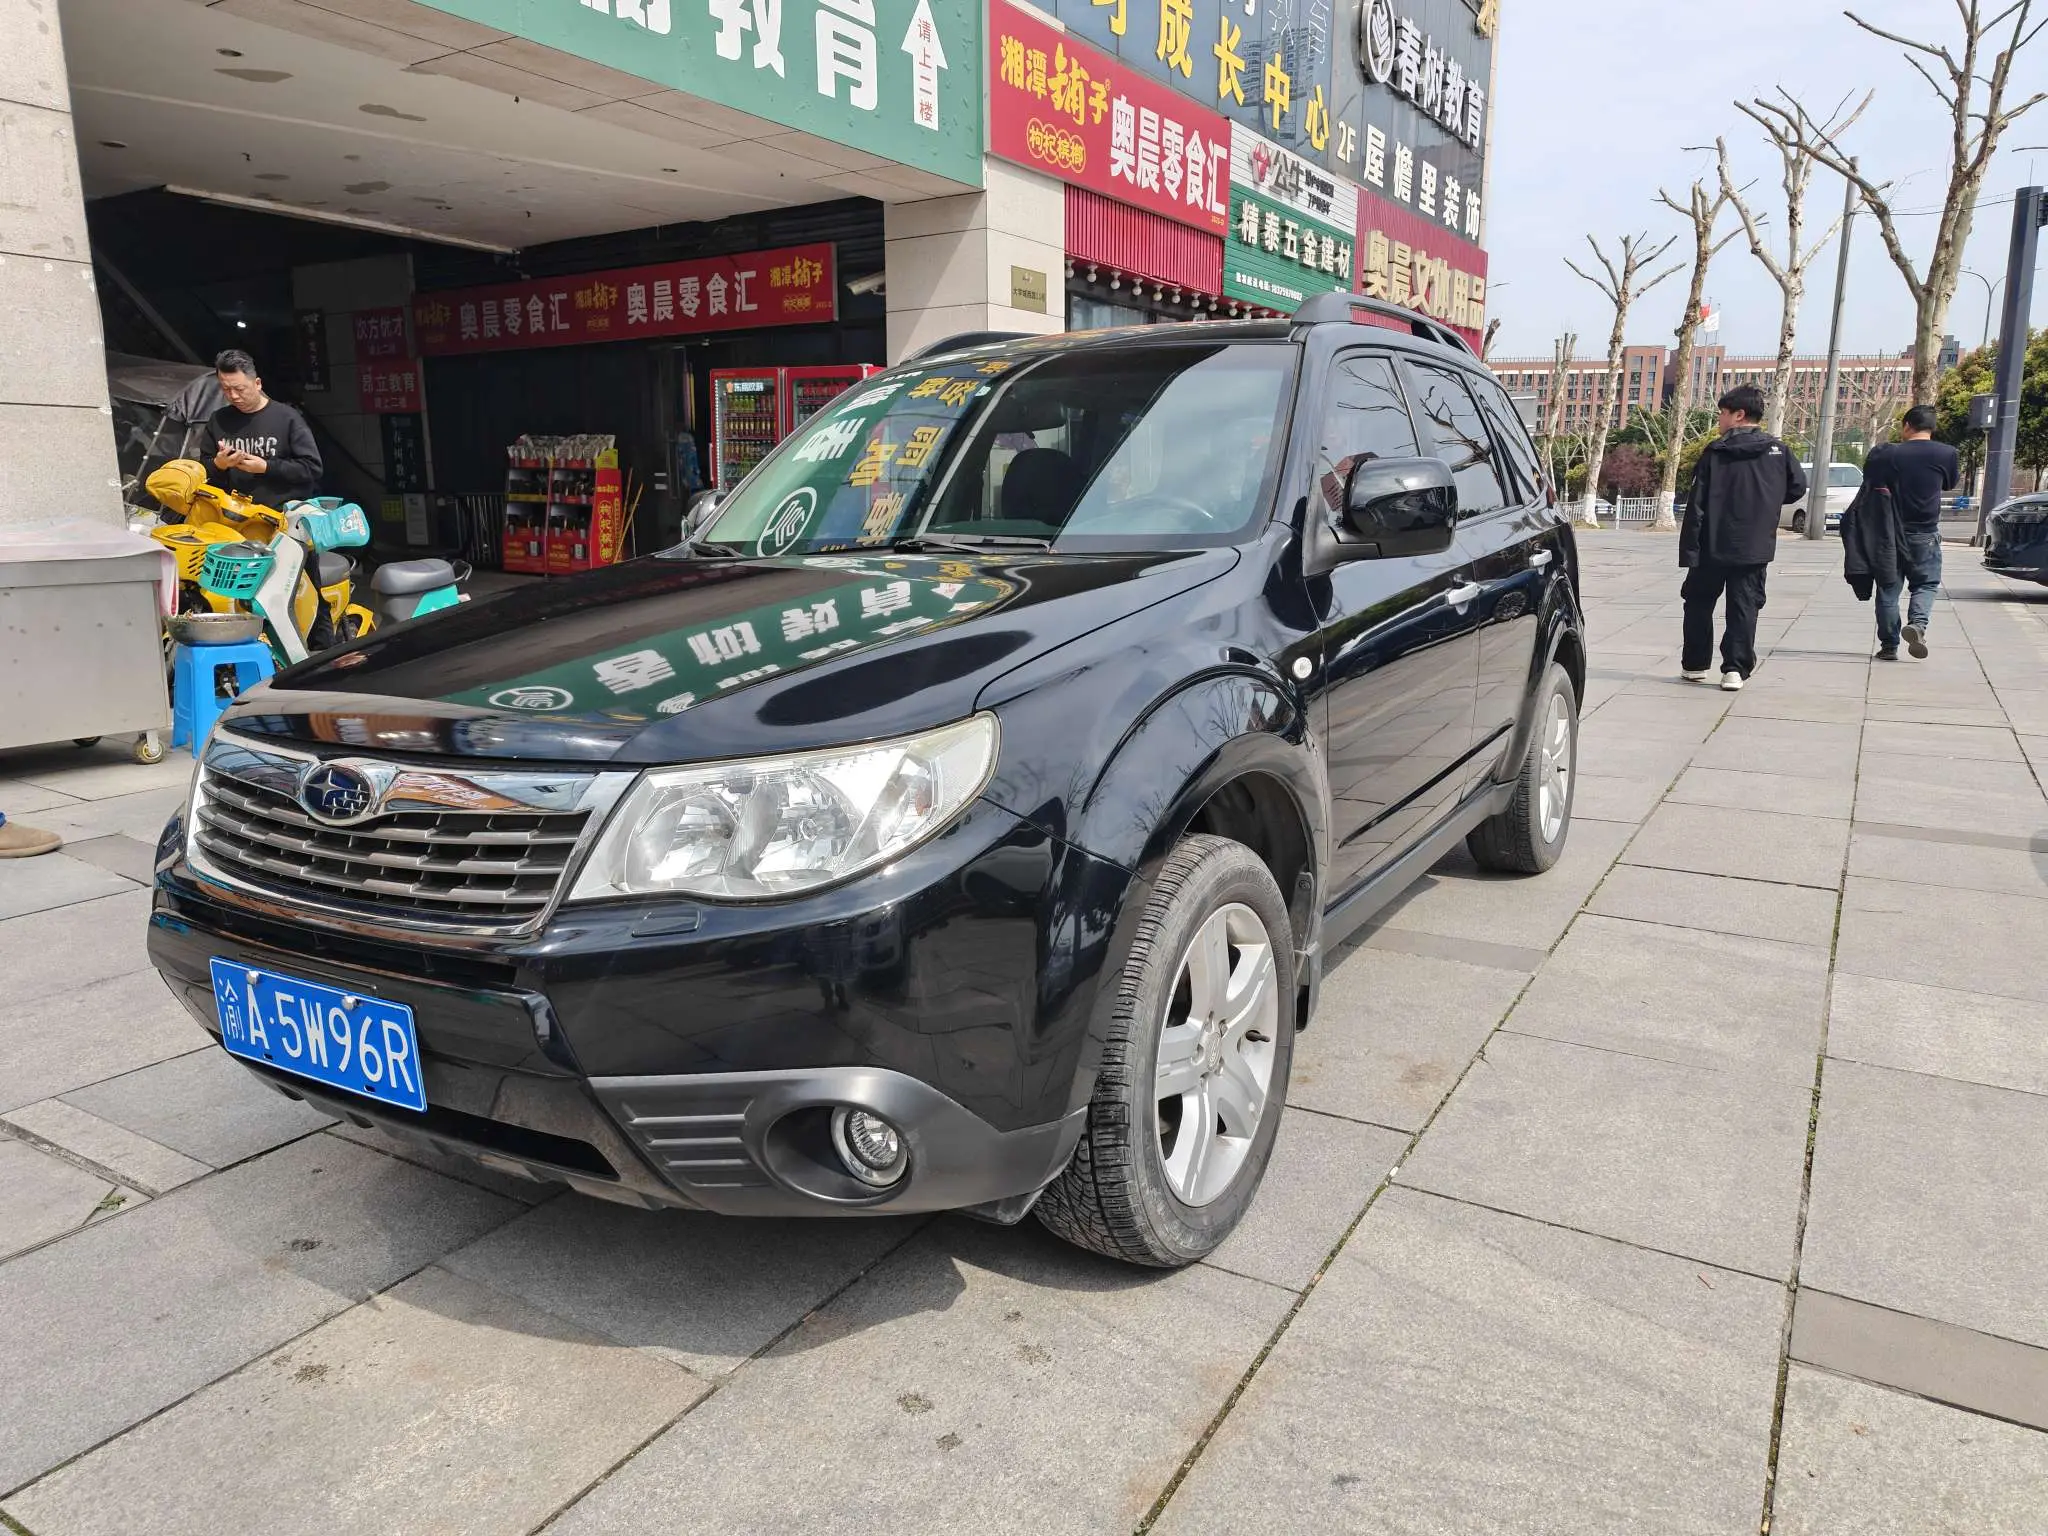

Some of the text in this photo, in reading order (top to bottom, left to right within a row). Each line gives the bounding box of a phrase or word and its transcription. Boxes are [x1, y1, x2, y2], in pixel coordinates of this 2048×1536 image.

[917, 17, 934, 124] 请上二楼
[1000, 34, 1109, 126] 湘潭铺子
[1397, 16, 1485, 148] 春树教育
[1110, 94, 1228, 216] 奥晨零食汇
[1269, 149, 1305, 198] 公牛
[1336, 121, 1481, 241] 2F 屋檐里装饰
[1240, 199, 1351, 279] 精泰五金建材
[1364, 230, 1485, 330] 奥晨文体用品
[460, 293, 570, 340] 奥晨零食汇
[627, 270, 758, 325] 奥晨零食汇
[361, 369, 416, 394] 昂立教育
